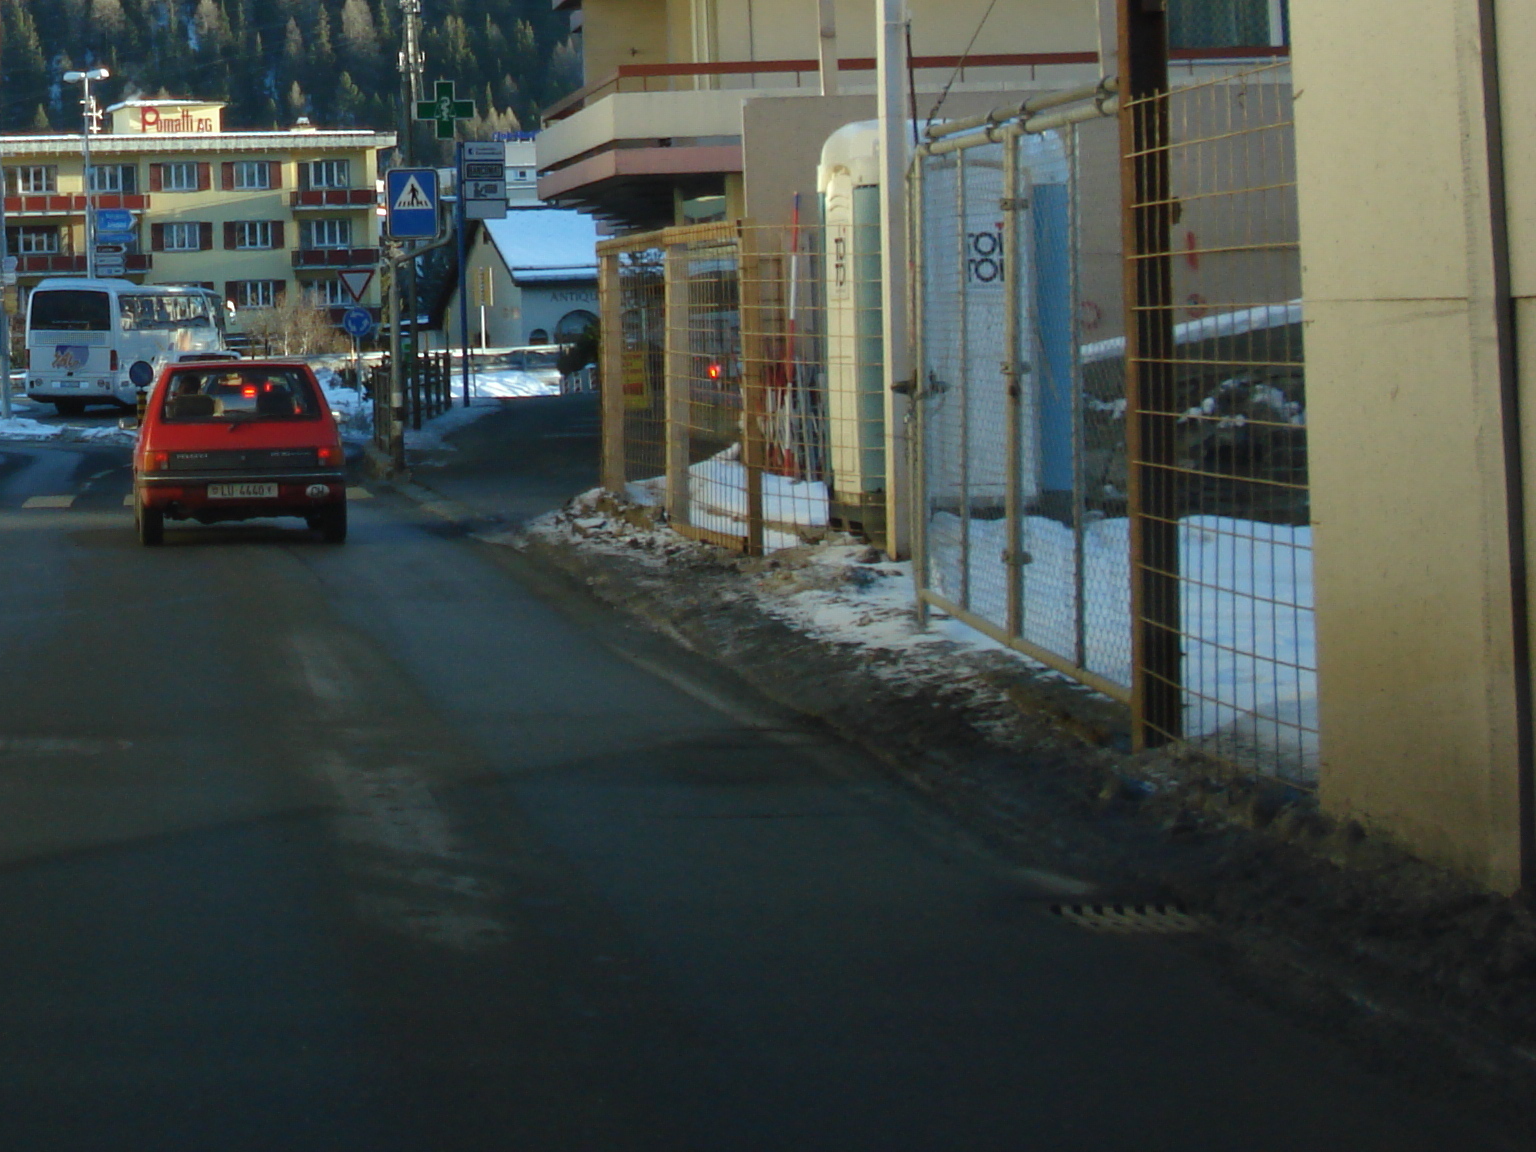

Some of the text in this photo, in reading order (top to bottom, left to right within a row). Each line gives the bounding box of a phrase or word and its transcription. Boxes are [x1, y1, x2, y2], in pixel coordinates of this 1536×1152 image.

[141, 106, 213, 133] Pomatti AG
[221, 485, 235, 497] LU
[310, 486, 325, 497] CH
